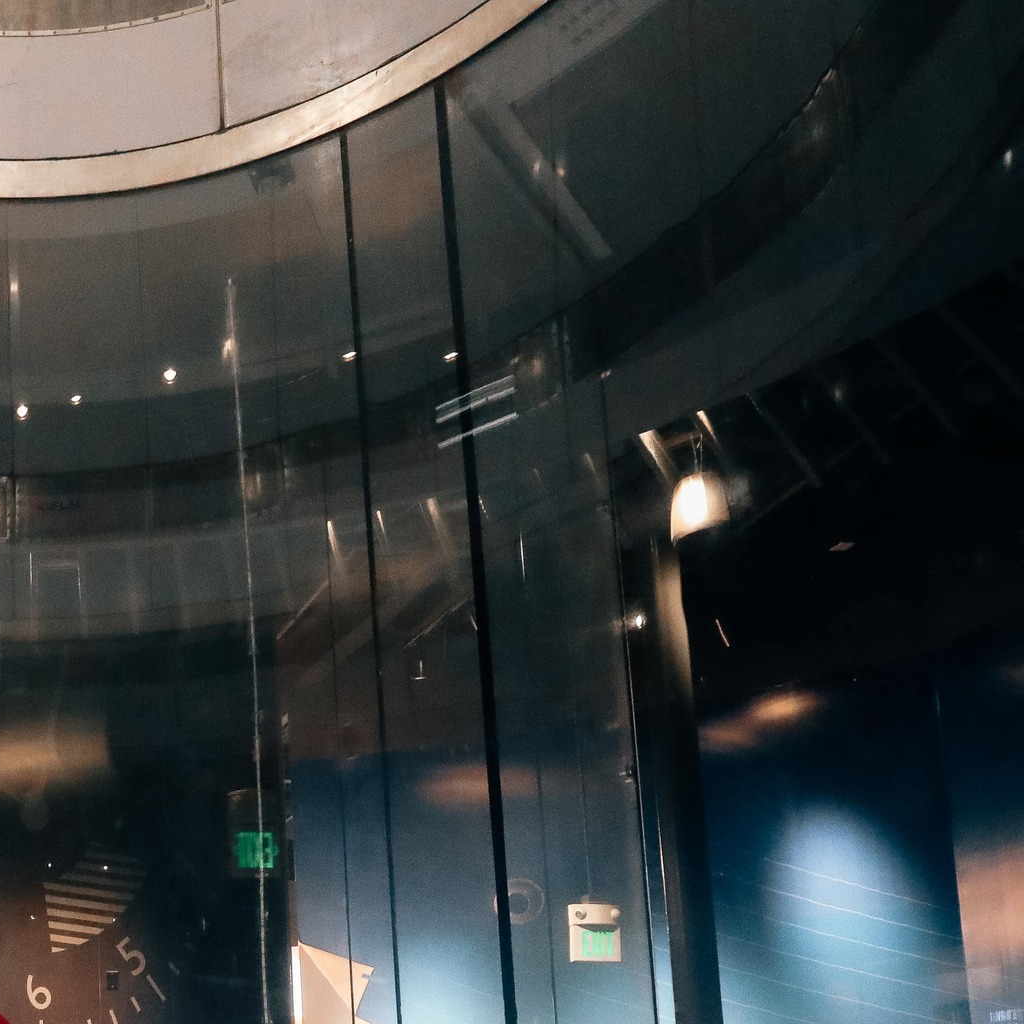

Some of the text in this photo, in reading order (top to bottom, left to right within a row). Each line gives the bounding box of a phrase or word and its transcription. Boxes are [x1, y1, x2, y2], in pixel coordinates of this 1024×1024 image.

[116, 936, 146, 976] 5
[582, 931, 613, 957] EXIT
[27, 975, 51, 1009] 6
